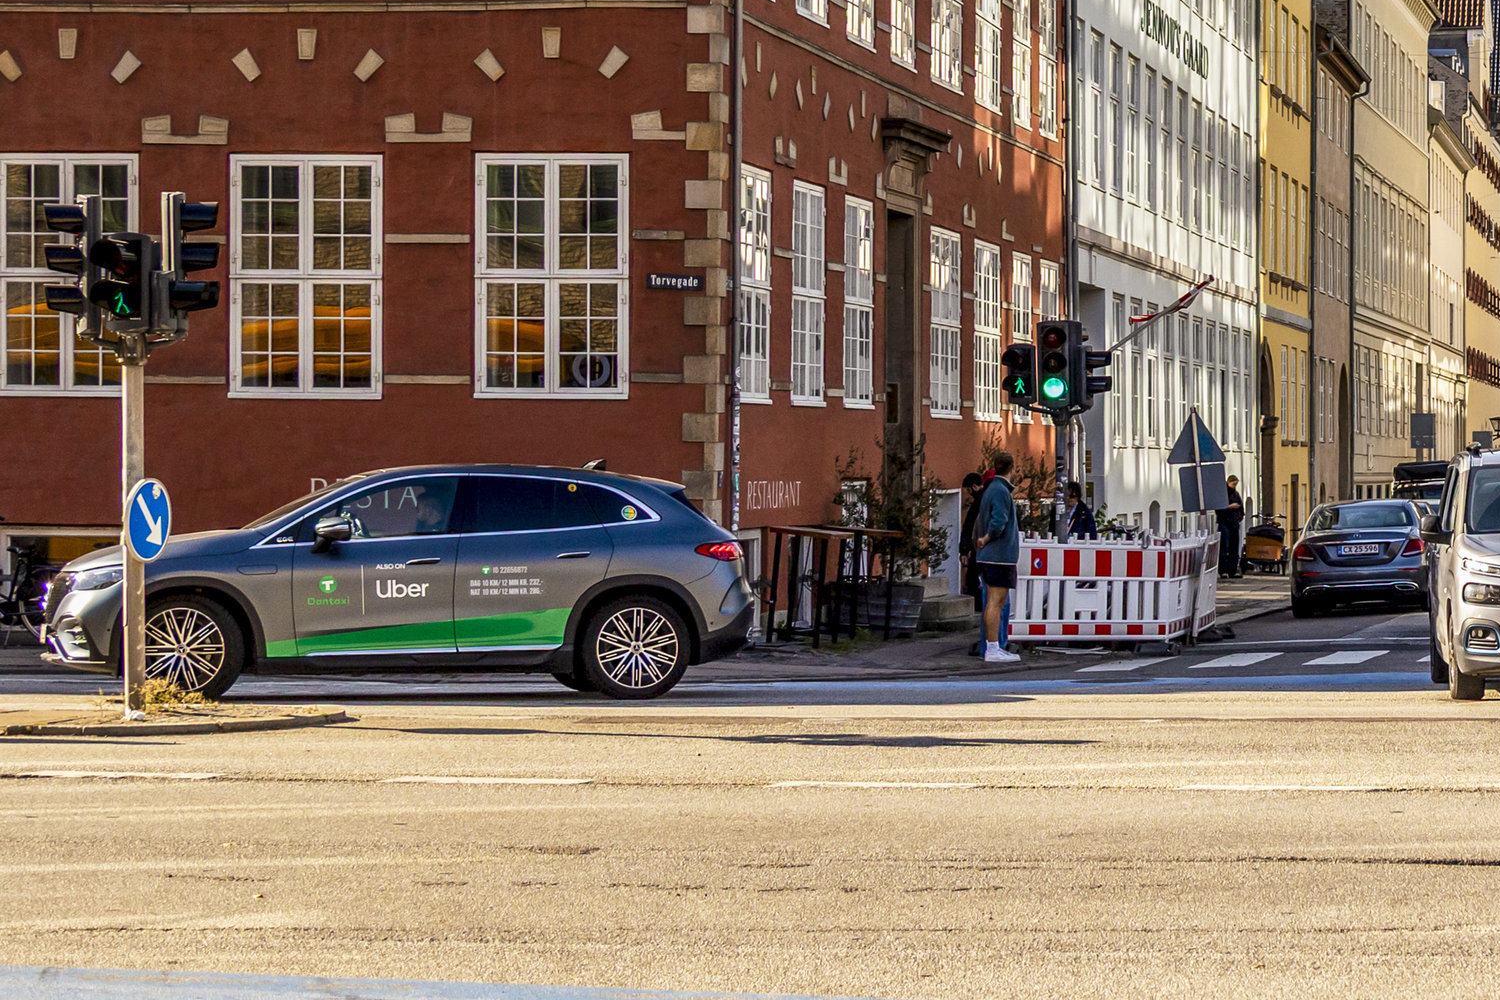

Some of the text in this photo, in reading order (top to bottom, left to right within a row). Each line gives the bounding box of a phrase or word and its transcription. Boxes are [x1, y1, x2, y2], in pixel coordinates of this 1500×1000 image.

[1183, 29, 1210, 80] GAARD
[650, 274, 698, 289] Torvegade
[747, 480, 802, 510] RESTAURANT
[1343, 546, 1352, 554] CX
[1354, 545, 1363, 553] 25
[376, 579, 430, 598] Uber
[306, 596, 350, 606] Dantaxi
